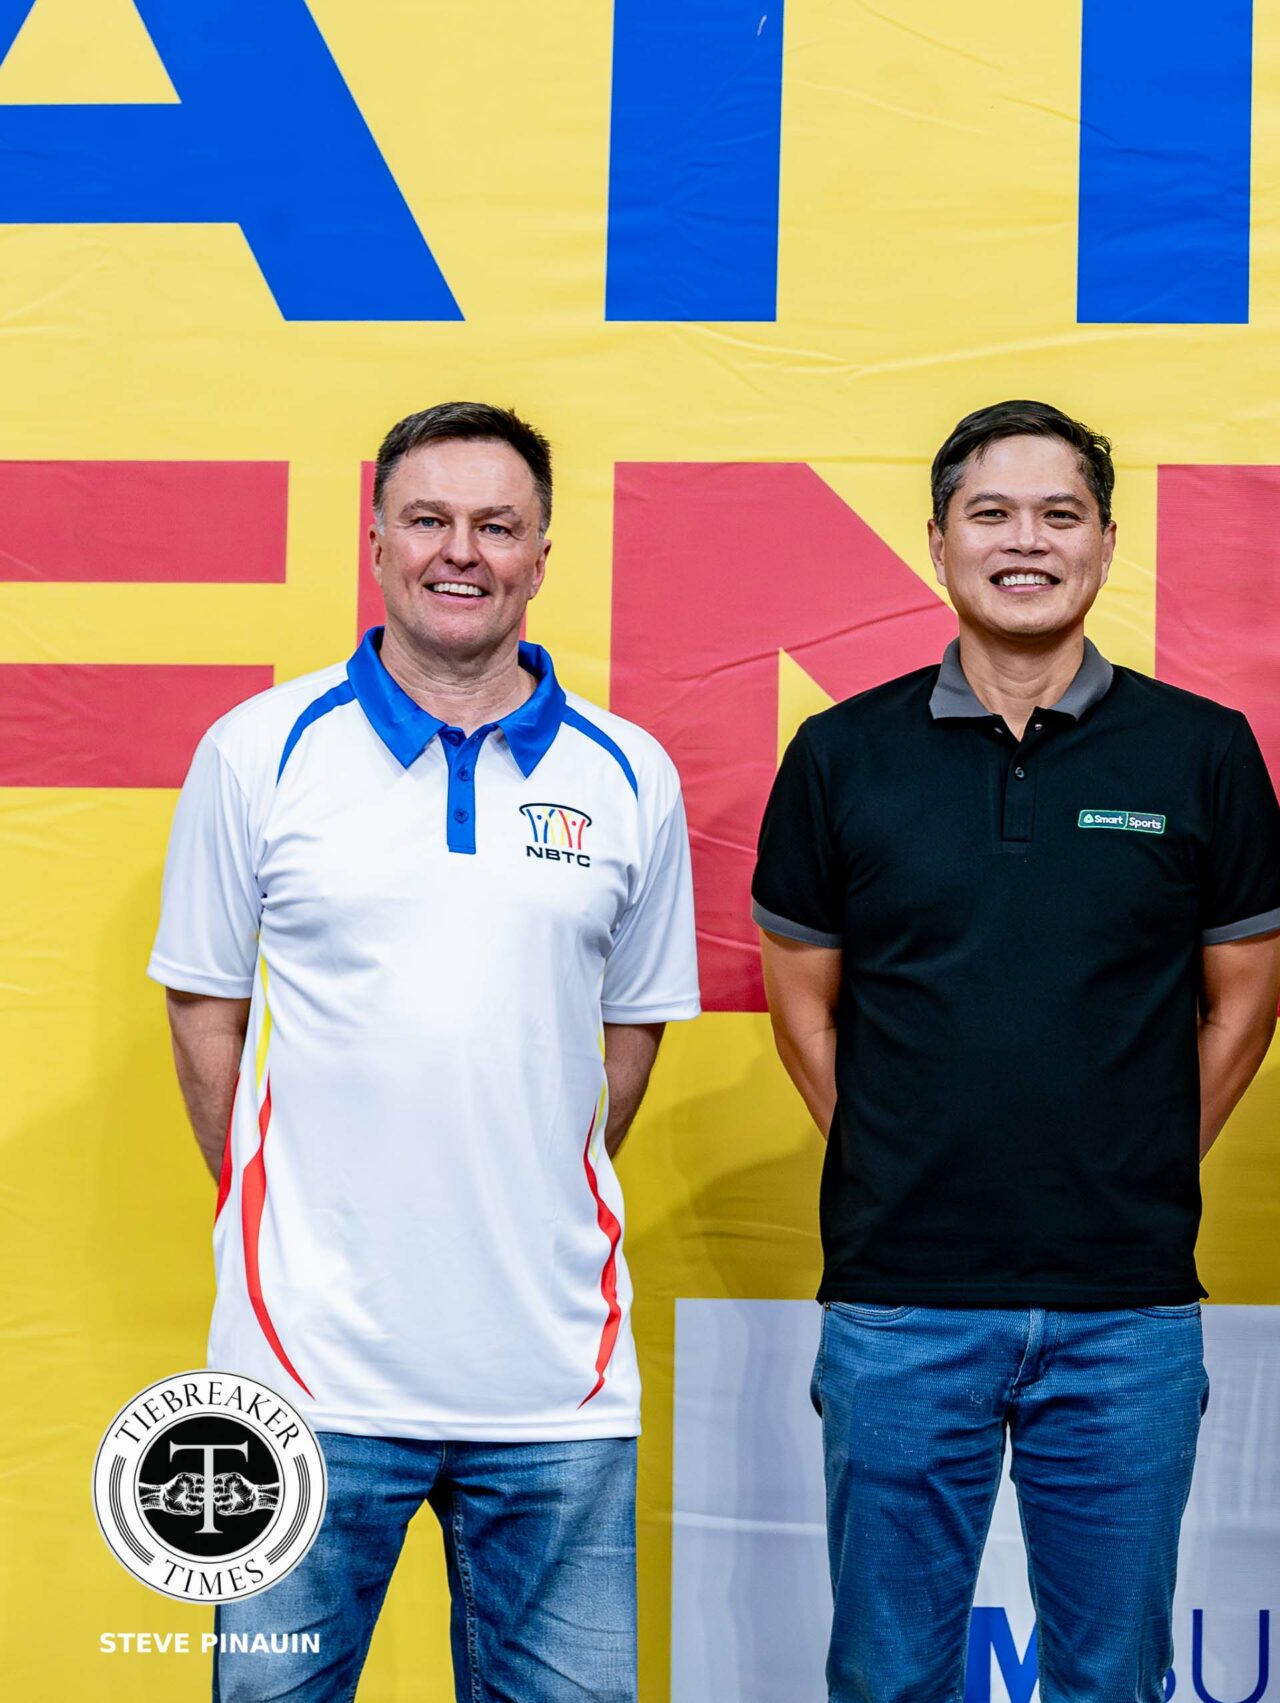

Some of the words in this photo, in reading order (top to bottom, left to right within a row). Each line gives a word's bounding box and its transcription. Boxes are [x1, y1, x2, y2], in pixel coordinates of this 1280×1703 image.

[1094, 815, 1123, 825] Smart
[1129, 817, 1161, 829] Sports
[526, 845, 591, 868] NBTC
